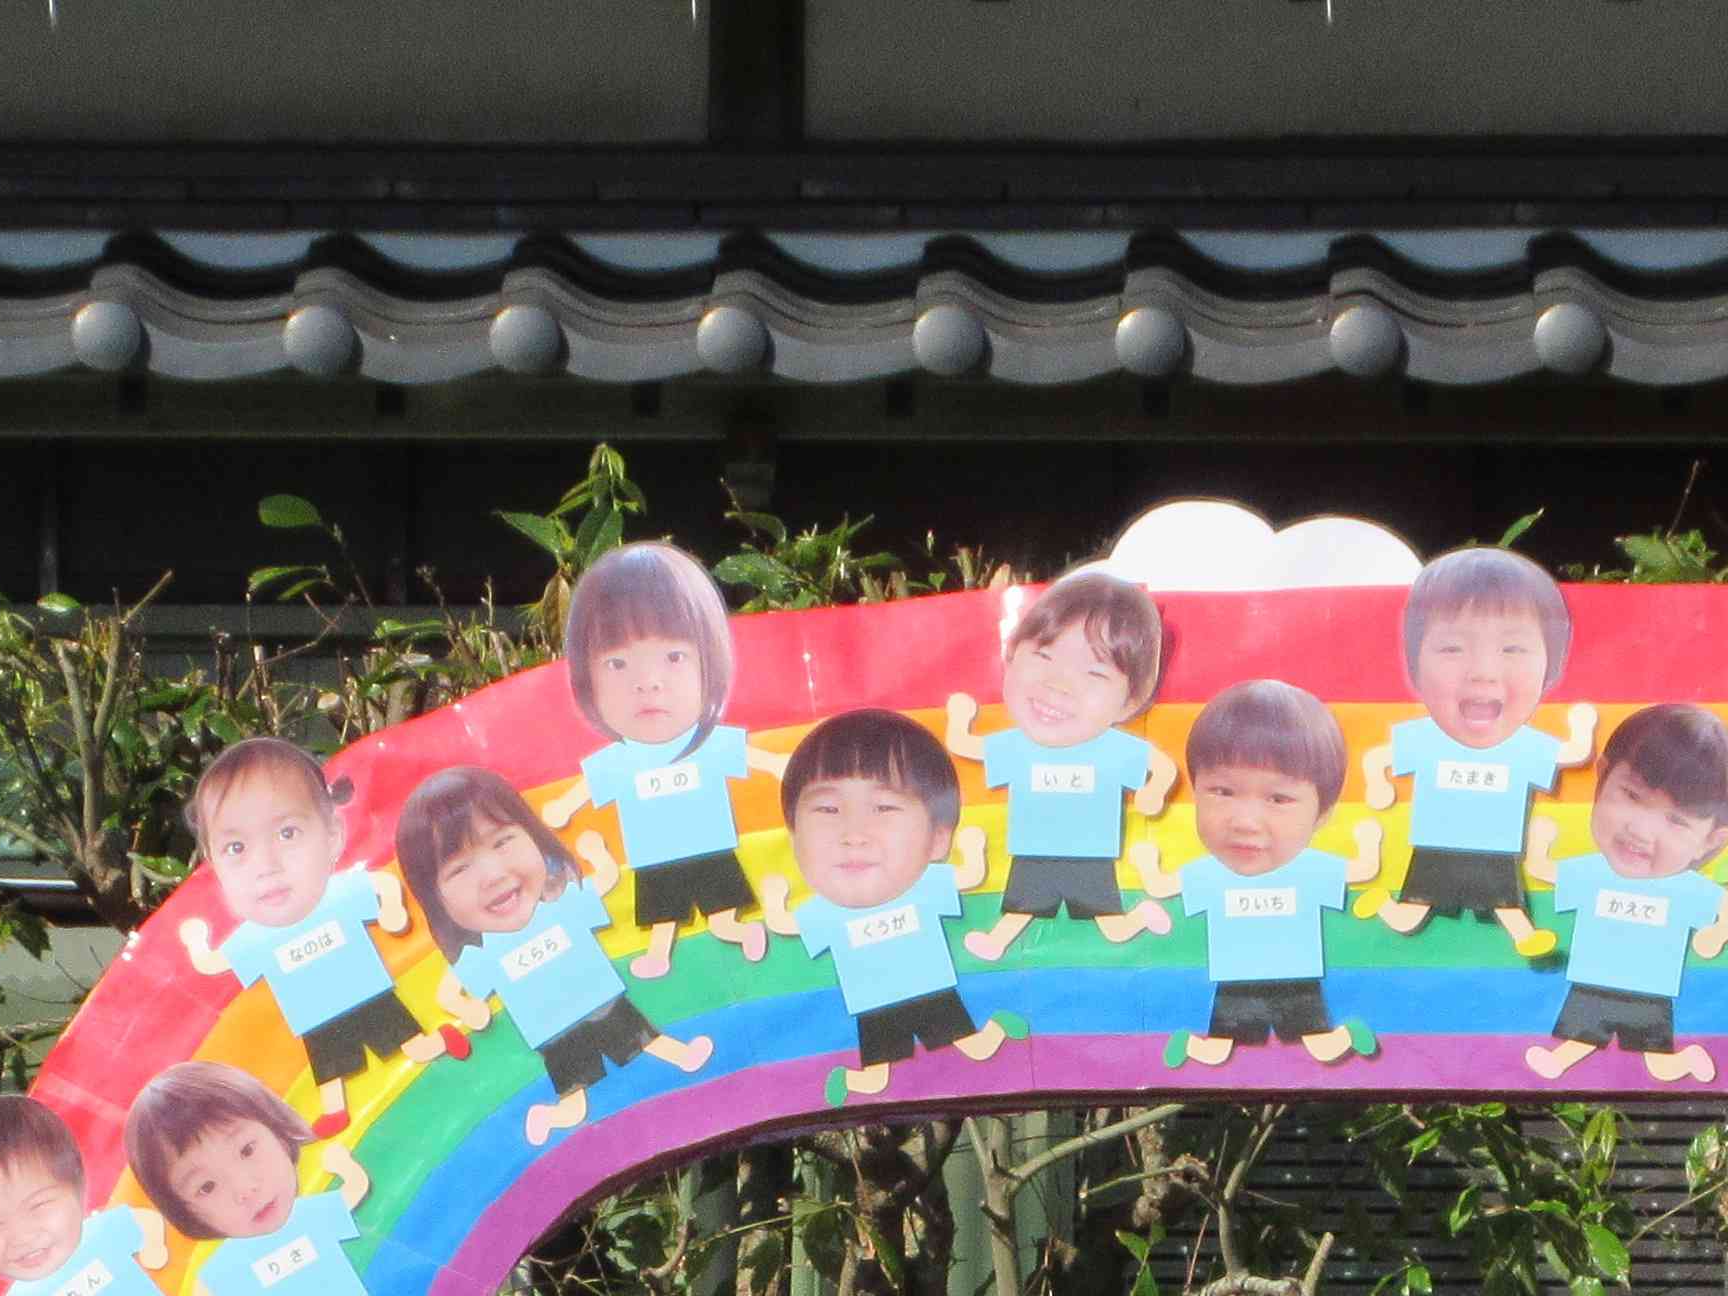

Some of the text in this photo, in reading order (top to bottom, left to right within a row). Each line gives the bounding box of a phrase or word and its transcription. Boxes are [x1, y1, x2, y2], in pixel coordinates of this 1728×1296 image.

[649, 772, 690, 793] りの
[1043, 772, 1084, 790] いと
[1448, 768, 1497, 787] たまき
[1238, 895, 1285, 912] りいち
[1607, 897, 1657, 920] かえで
[862, 913, 907, 937] くうが
[288, 931, 335, 963] なのは
[516, 937, 559, 968] くらら
[267, 1247, 306, 1277] りさ
